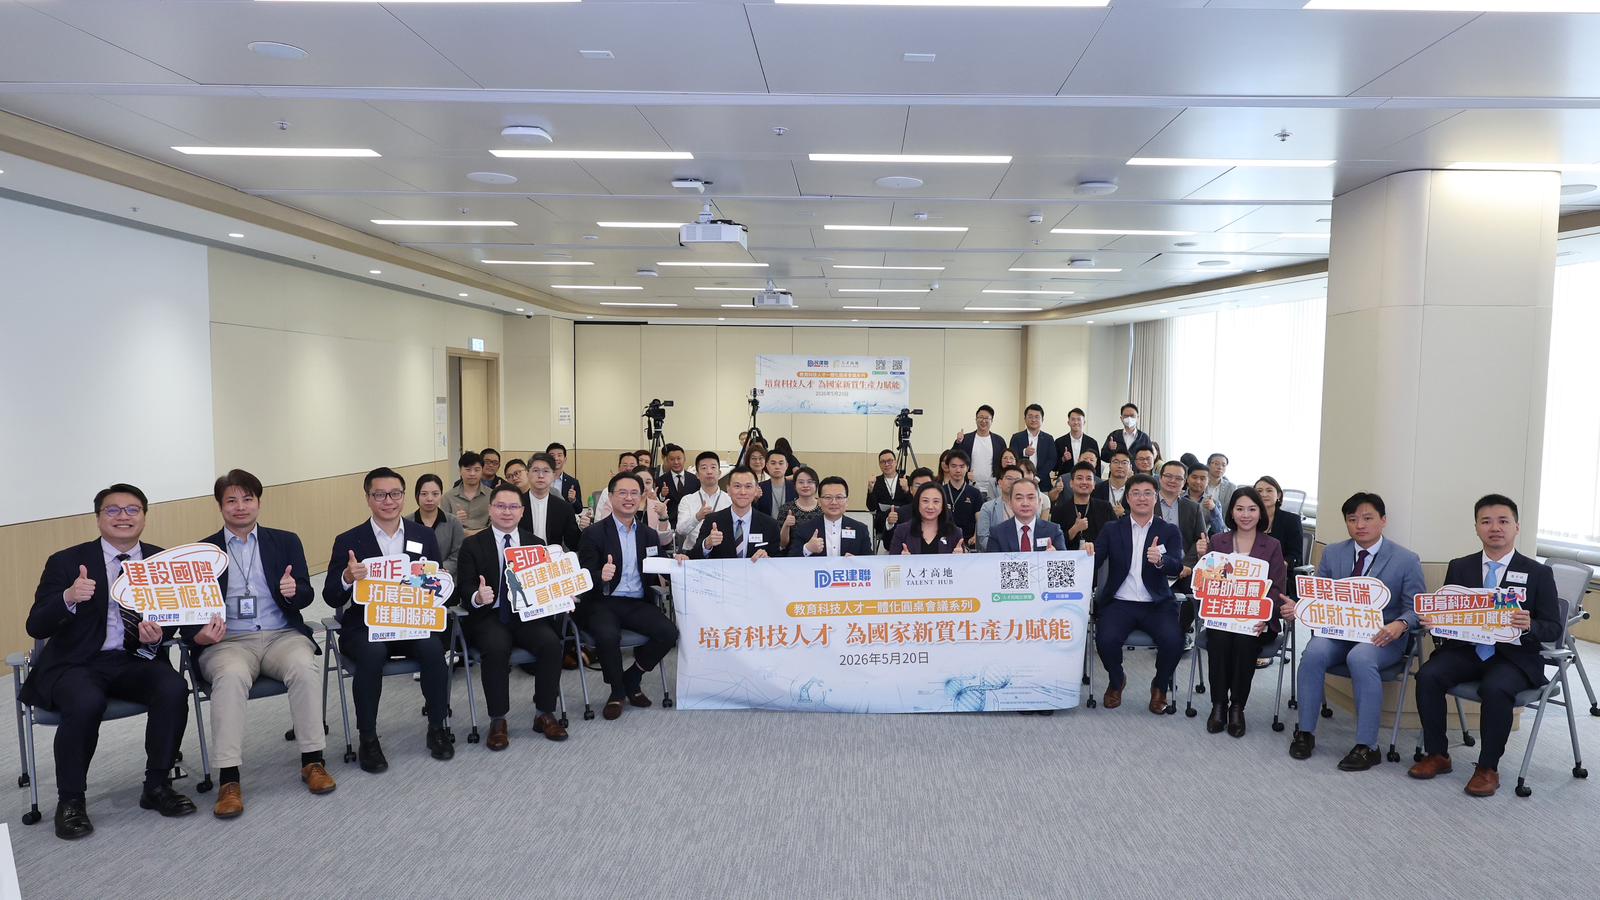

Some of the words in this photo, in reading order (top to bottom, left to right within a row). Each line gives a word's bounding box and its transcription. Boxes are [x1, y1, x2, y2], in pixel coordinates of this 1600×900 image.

[123, 560, 216, 587] 建設國際
[370, 559, 402, 580] 協作
[832, 569, 872, 582] 民建聯
[906, 567, 953, 578] 人才高地
[1234, 560, 1261, 577] 留才
[132, 585, 223, 611] 教育樞紐
[368, 583, 430, 606] 拓展合作
[1297, 577, 1371, 605] 匯聚高端
[1420, 595, 1489, 612] 培育科技人才
[375, 605, 437, 626] 推動服務
[1309, 603, 1382, 630] 成就未來
[698, 623, 833, 648] 培育科技人才
[846, 618, 1073, 646] 為國家新質生產力賦能
[839, 651, 929, 666] 2026年5月20日
